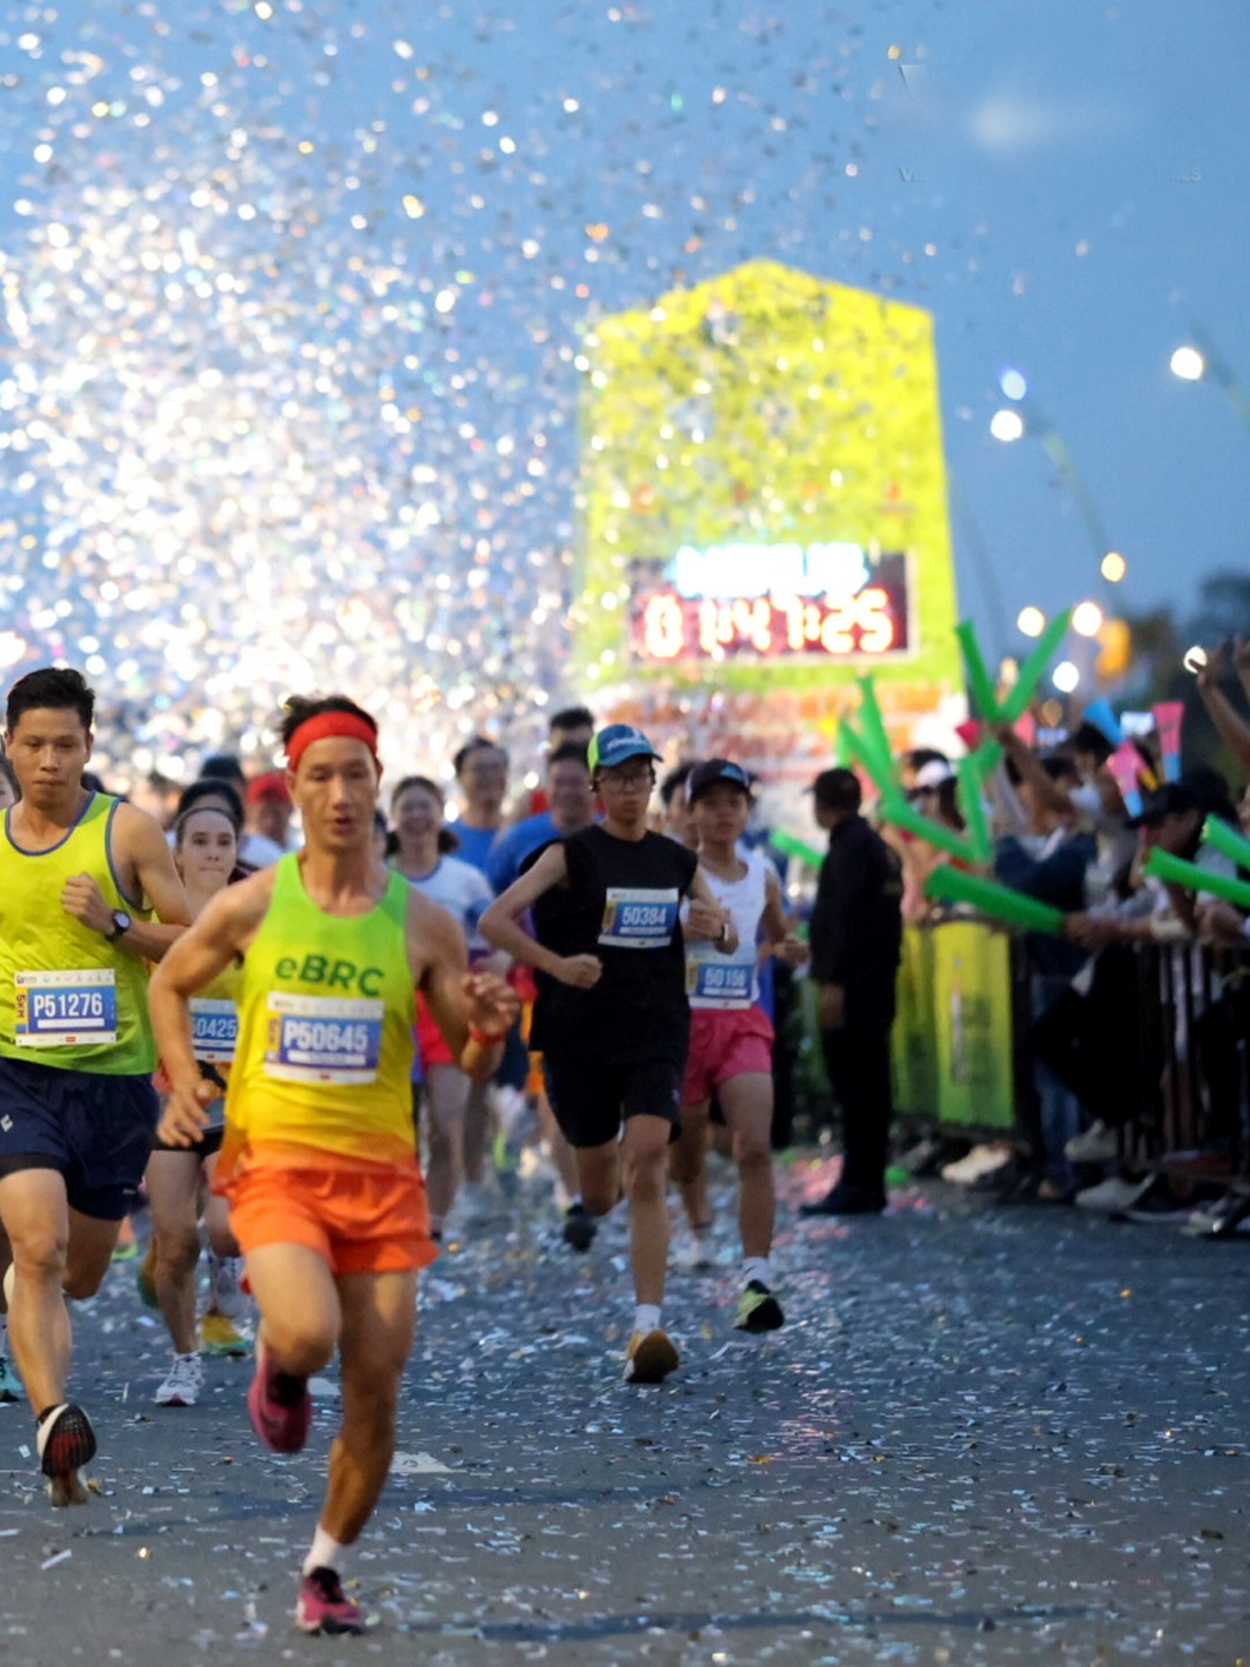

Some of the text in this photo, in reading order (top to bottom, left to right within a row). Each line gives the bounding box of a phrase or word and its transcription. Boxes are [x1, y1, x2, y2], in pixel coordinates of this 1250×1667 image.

[275, 954, 385, 998] eBRC
[33, 993, 103, 1018] P51276
[192, 1017, 238, 1038] 0425
[283, 1019, 369, 1053] P50645
